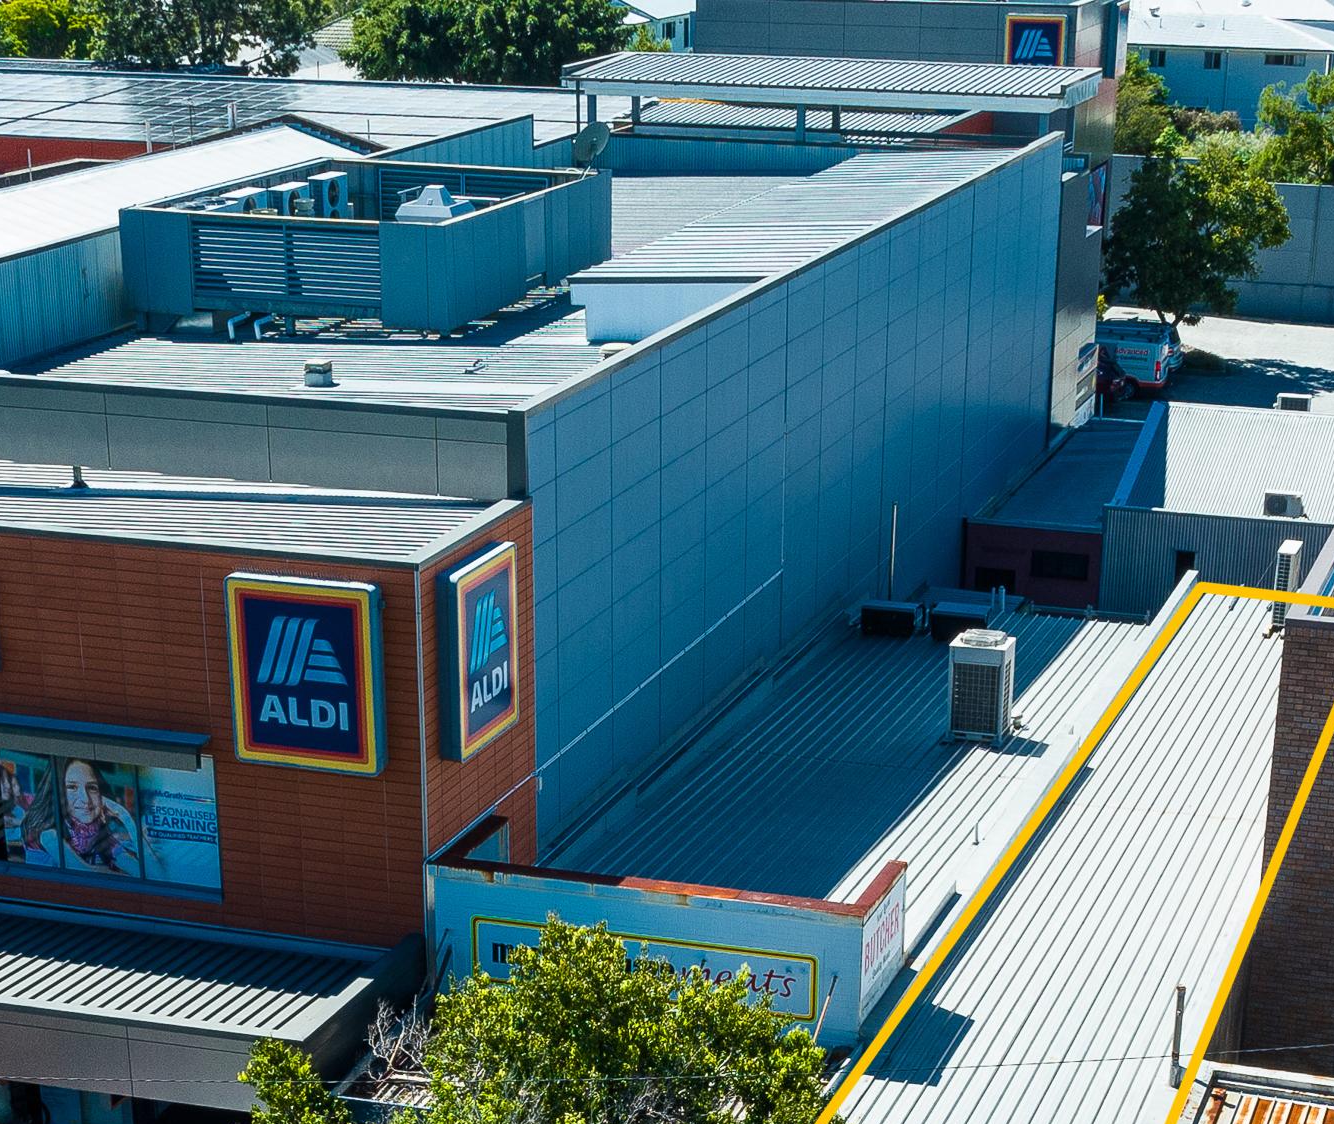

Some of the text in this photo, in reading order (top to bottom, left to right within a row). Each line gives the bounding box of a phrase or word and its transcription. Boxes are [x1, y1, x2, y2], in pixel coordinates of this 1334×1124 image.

[470, 660, 508, 713] ALDI
[259, 694, 349, 731] ALDI
[145, 815, 217, 833] LEARNING
[146, 804, 216, 821] ERSONALISED
[865, 901, 900, 976] BUTCHER
